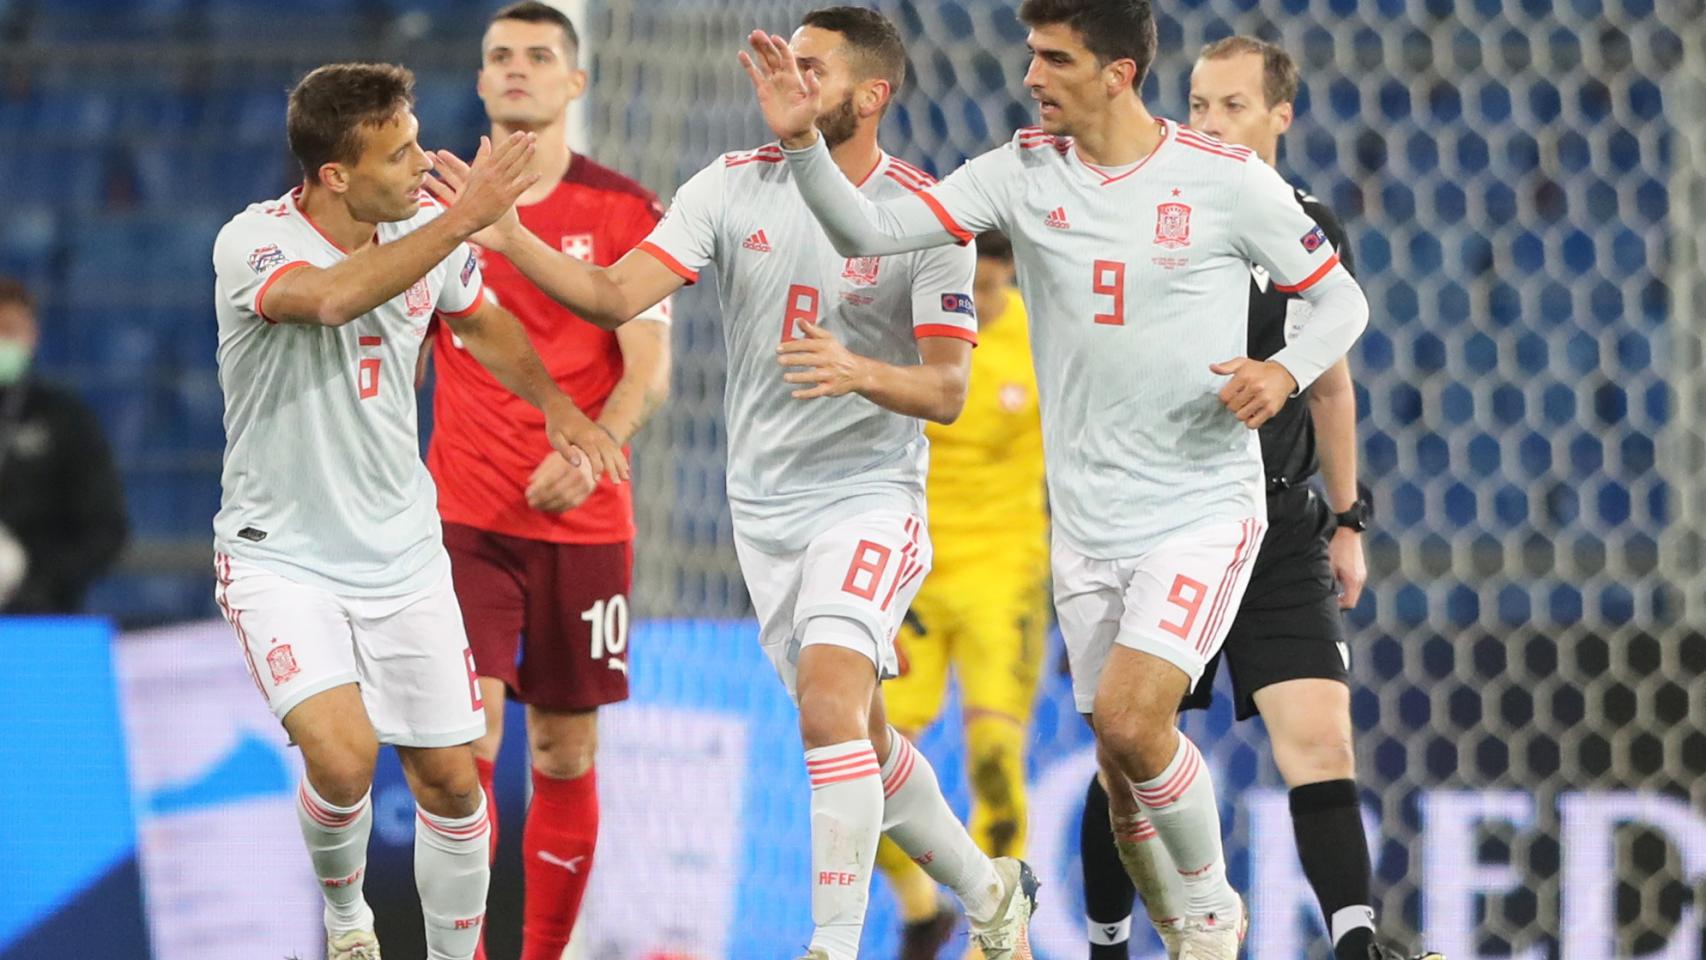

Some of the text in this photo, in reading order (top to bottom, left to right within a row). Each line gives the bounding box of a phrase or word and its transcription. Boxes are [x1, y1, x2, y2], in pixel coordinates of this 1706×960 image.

[1093, 260, 1125, 326] 9
[842, 540, 891, 601] 8
[581, 594, 628, 659] 10
[1158, 573, 1208, 640] 9
